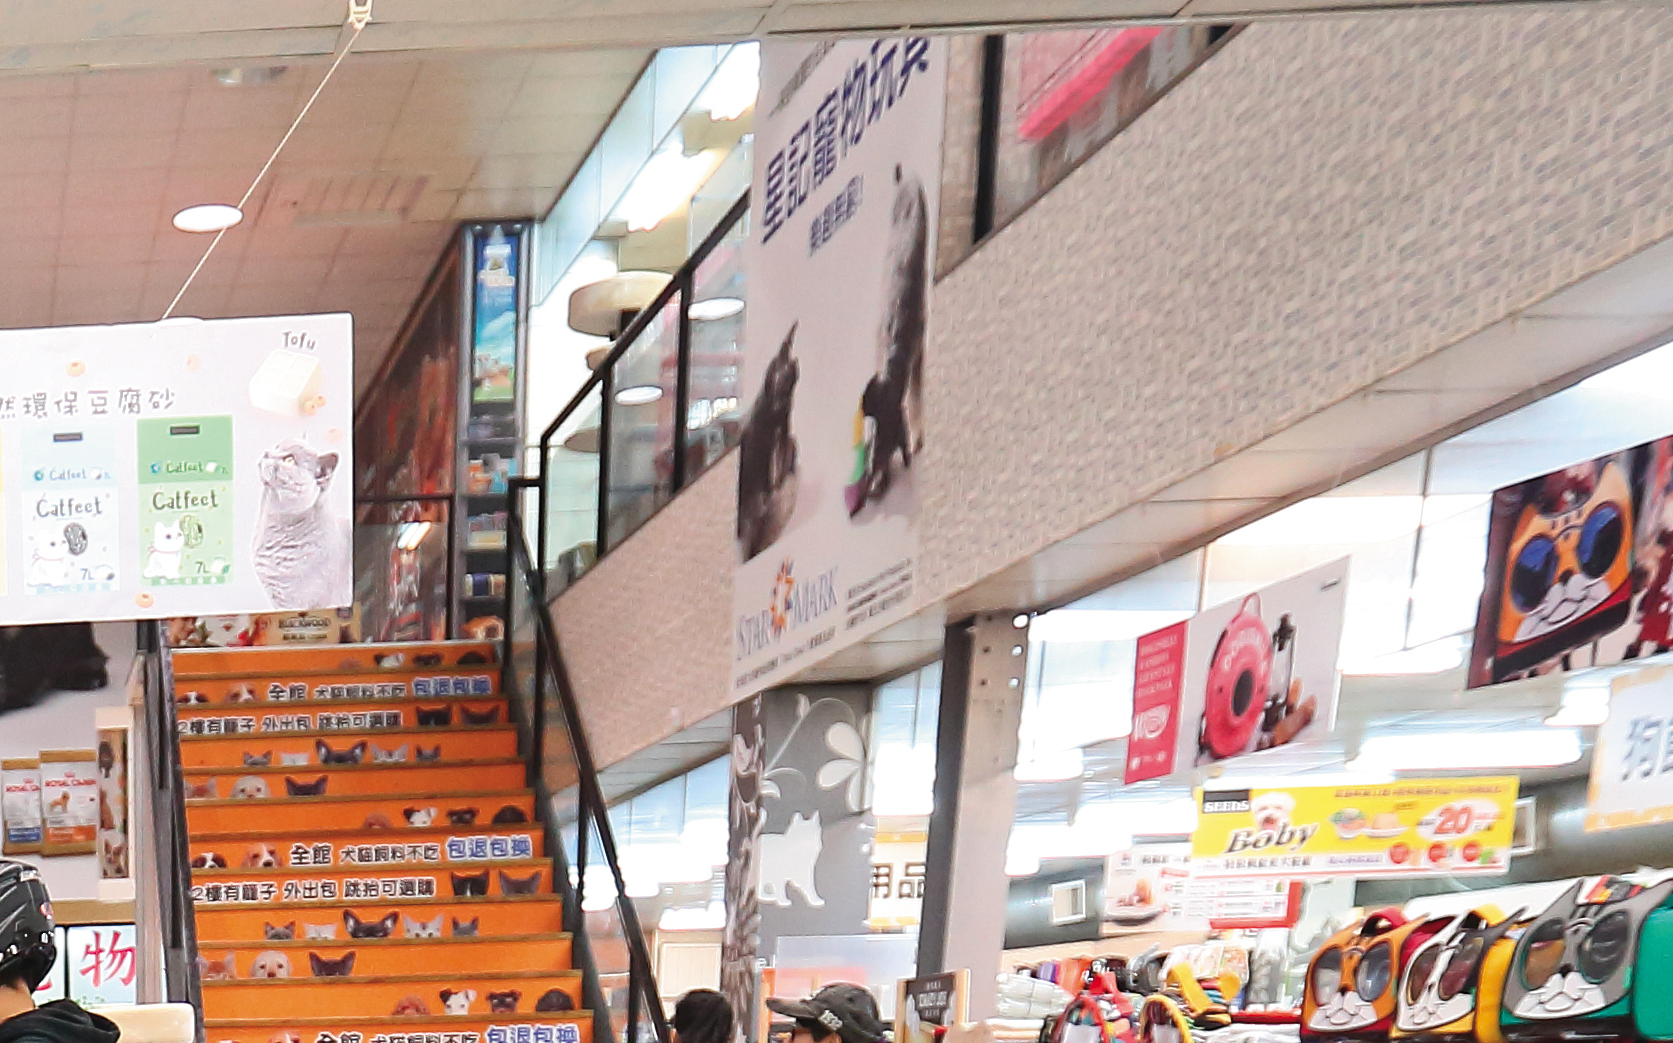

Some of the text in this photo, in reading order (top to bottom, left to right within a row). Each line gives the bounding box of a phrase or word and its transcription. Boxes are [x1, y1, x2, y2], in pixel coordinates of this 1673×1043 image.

[282, 331, 316, 351] Tofu
[37, 497, 103, 517] Catfeet
[152, 489, 218, 511] Catfeet
[1623, 714, 1673, 782] 狗
[1203, 799, 1249, 813] SEEDS
[1435, 805, 1473, 834] 20
[291, 836, 533, 865] 全館 犬貓飼料不吃 包退包換
[284, 880, 336, 900] 外出包
